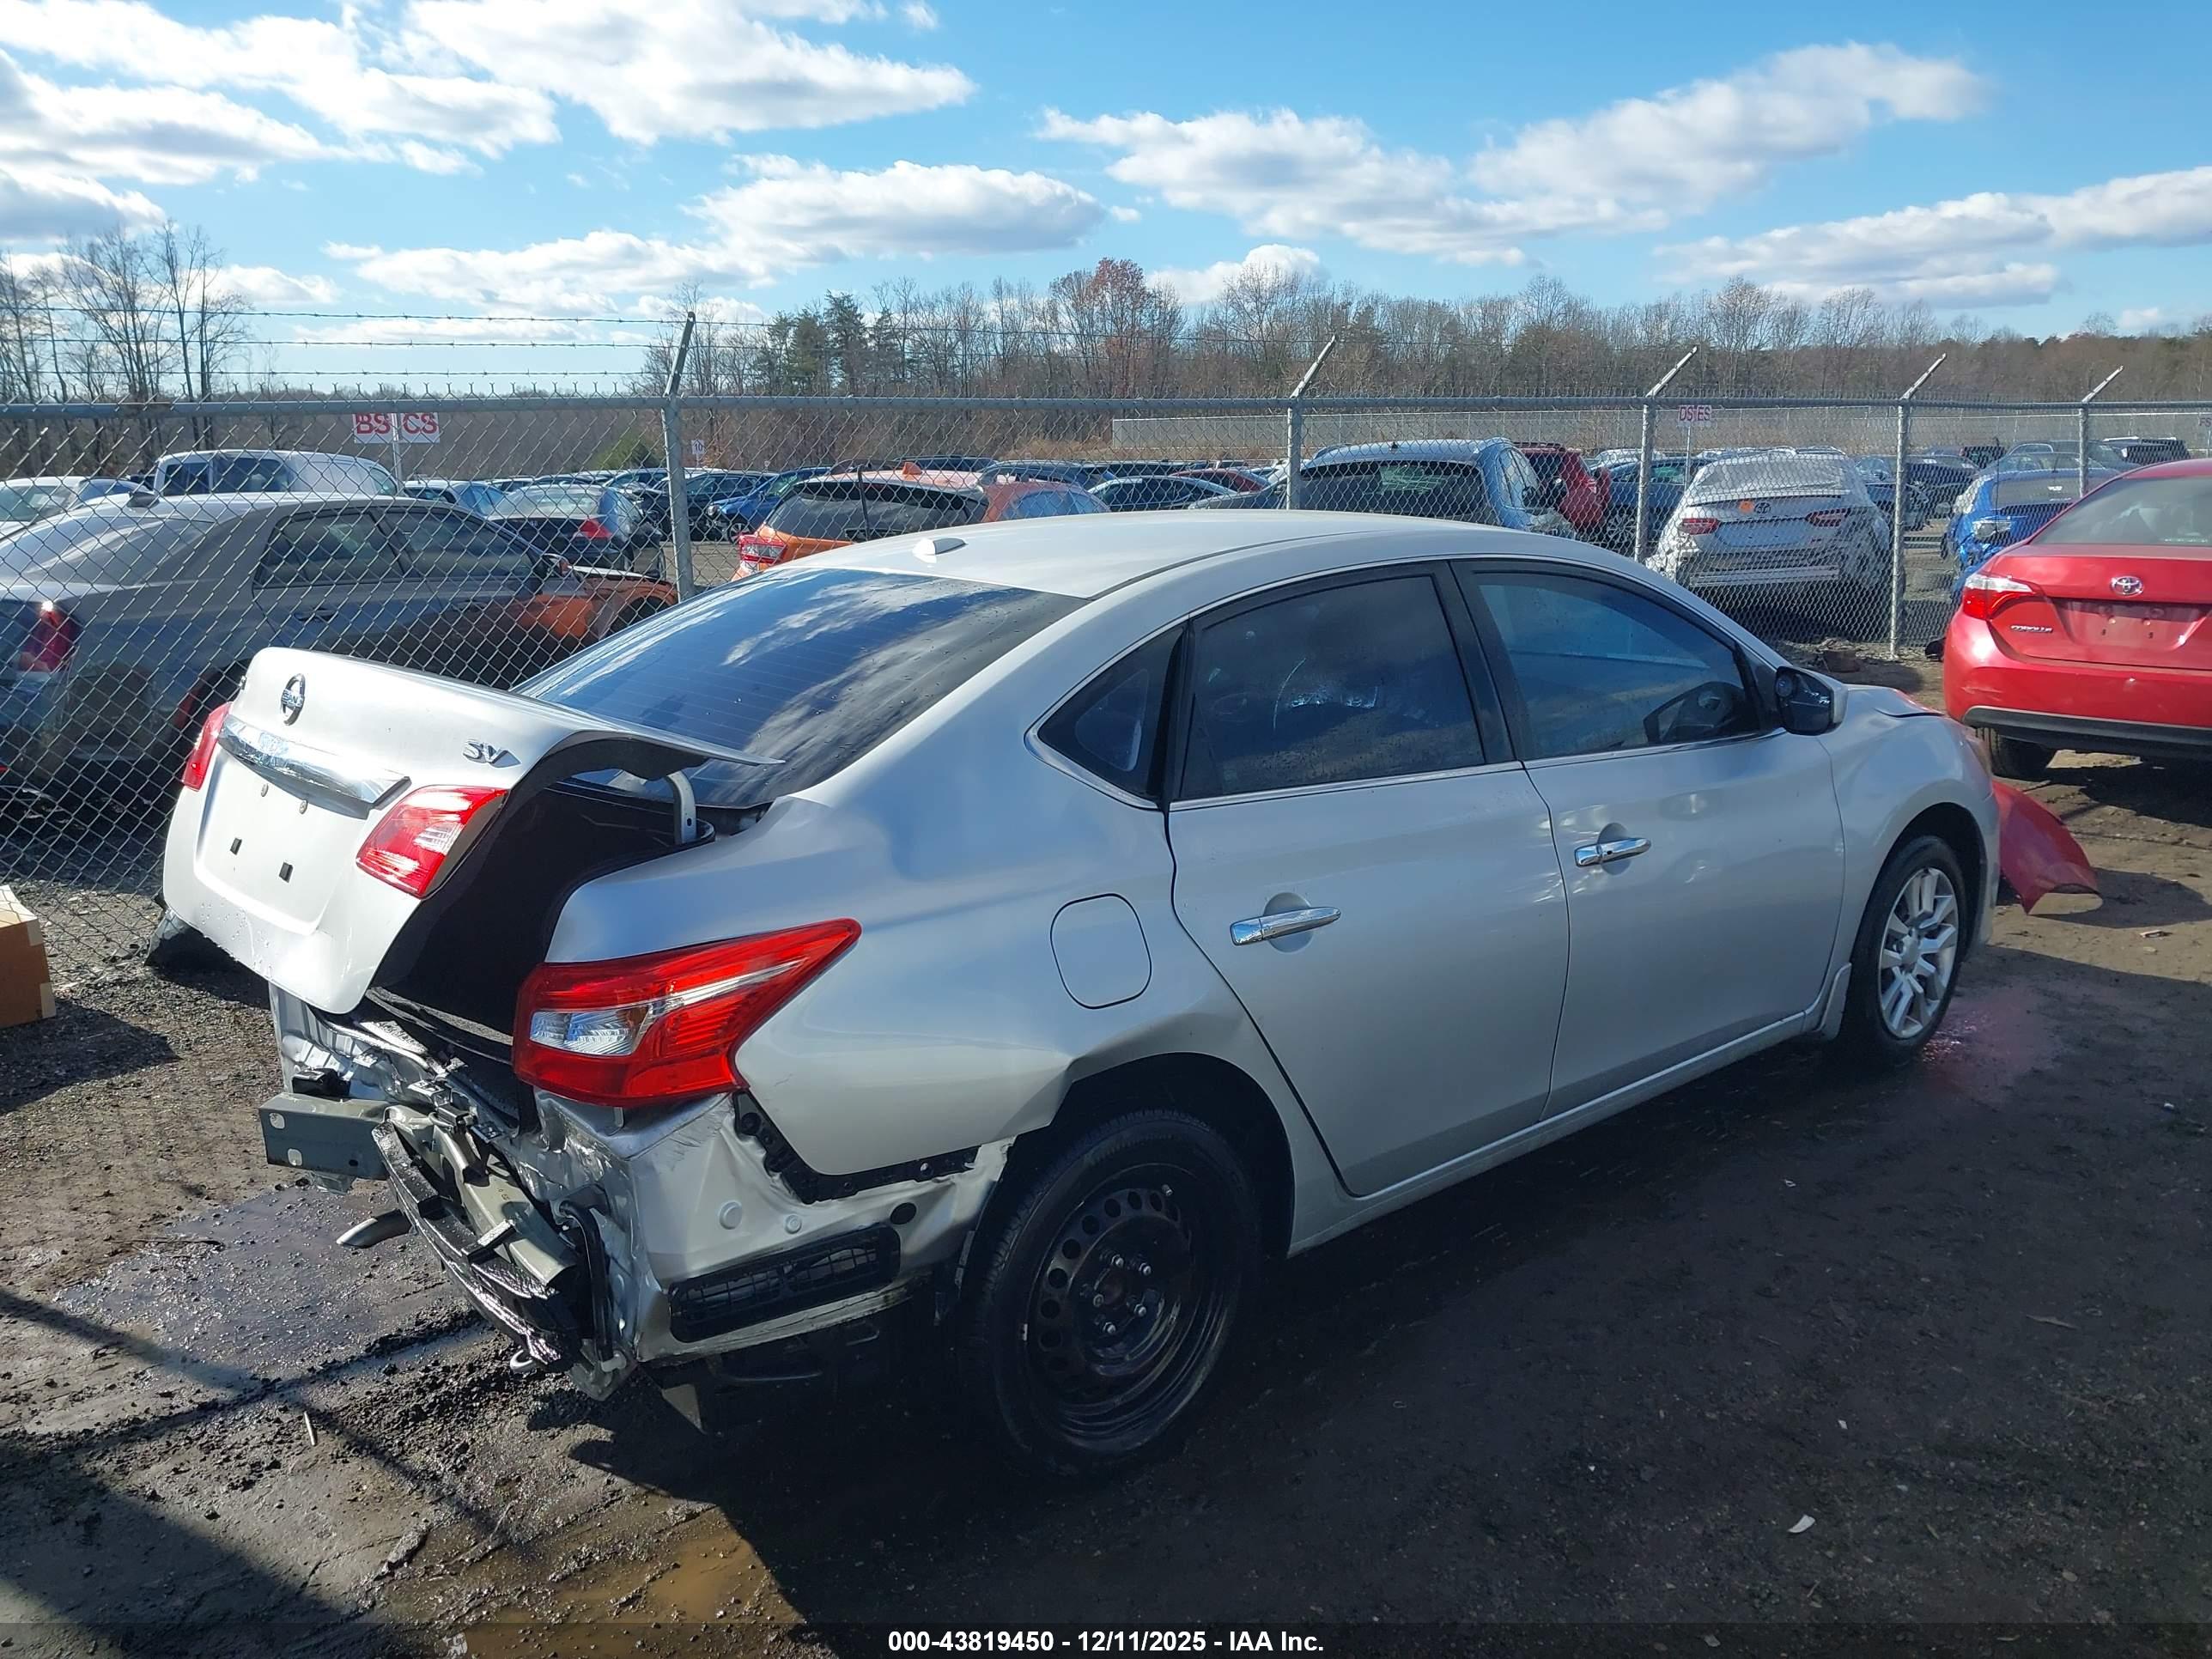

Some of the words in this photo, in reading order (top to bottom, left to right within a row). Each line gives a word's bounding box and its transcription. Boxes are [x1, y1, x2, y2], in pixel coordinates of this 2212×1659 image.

[356, 413, 392, 434] BS
[403, 413, 438, 434] CS
[694, 442, 703, 453] 10
[462, 739, 517, 768] SV
